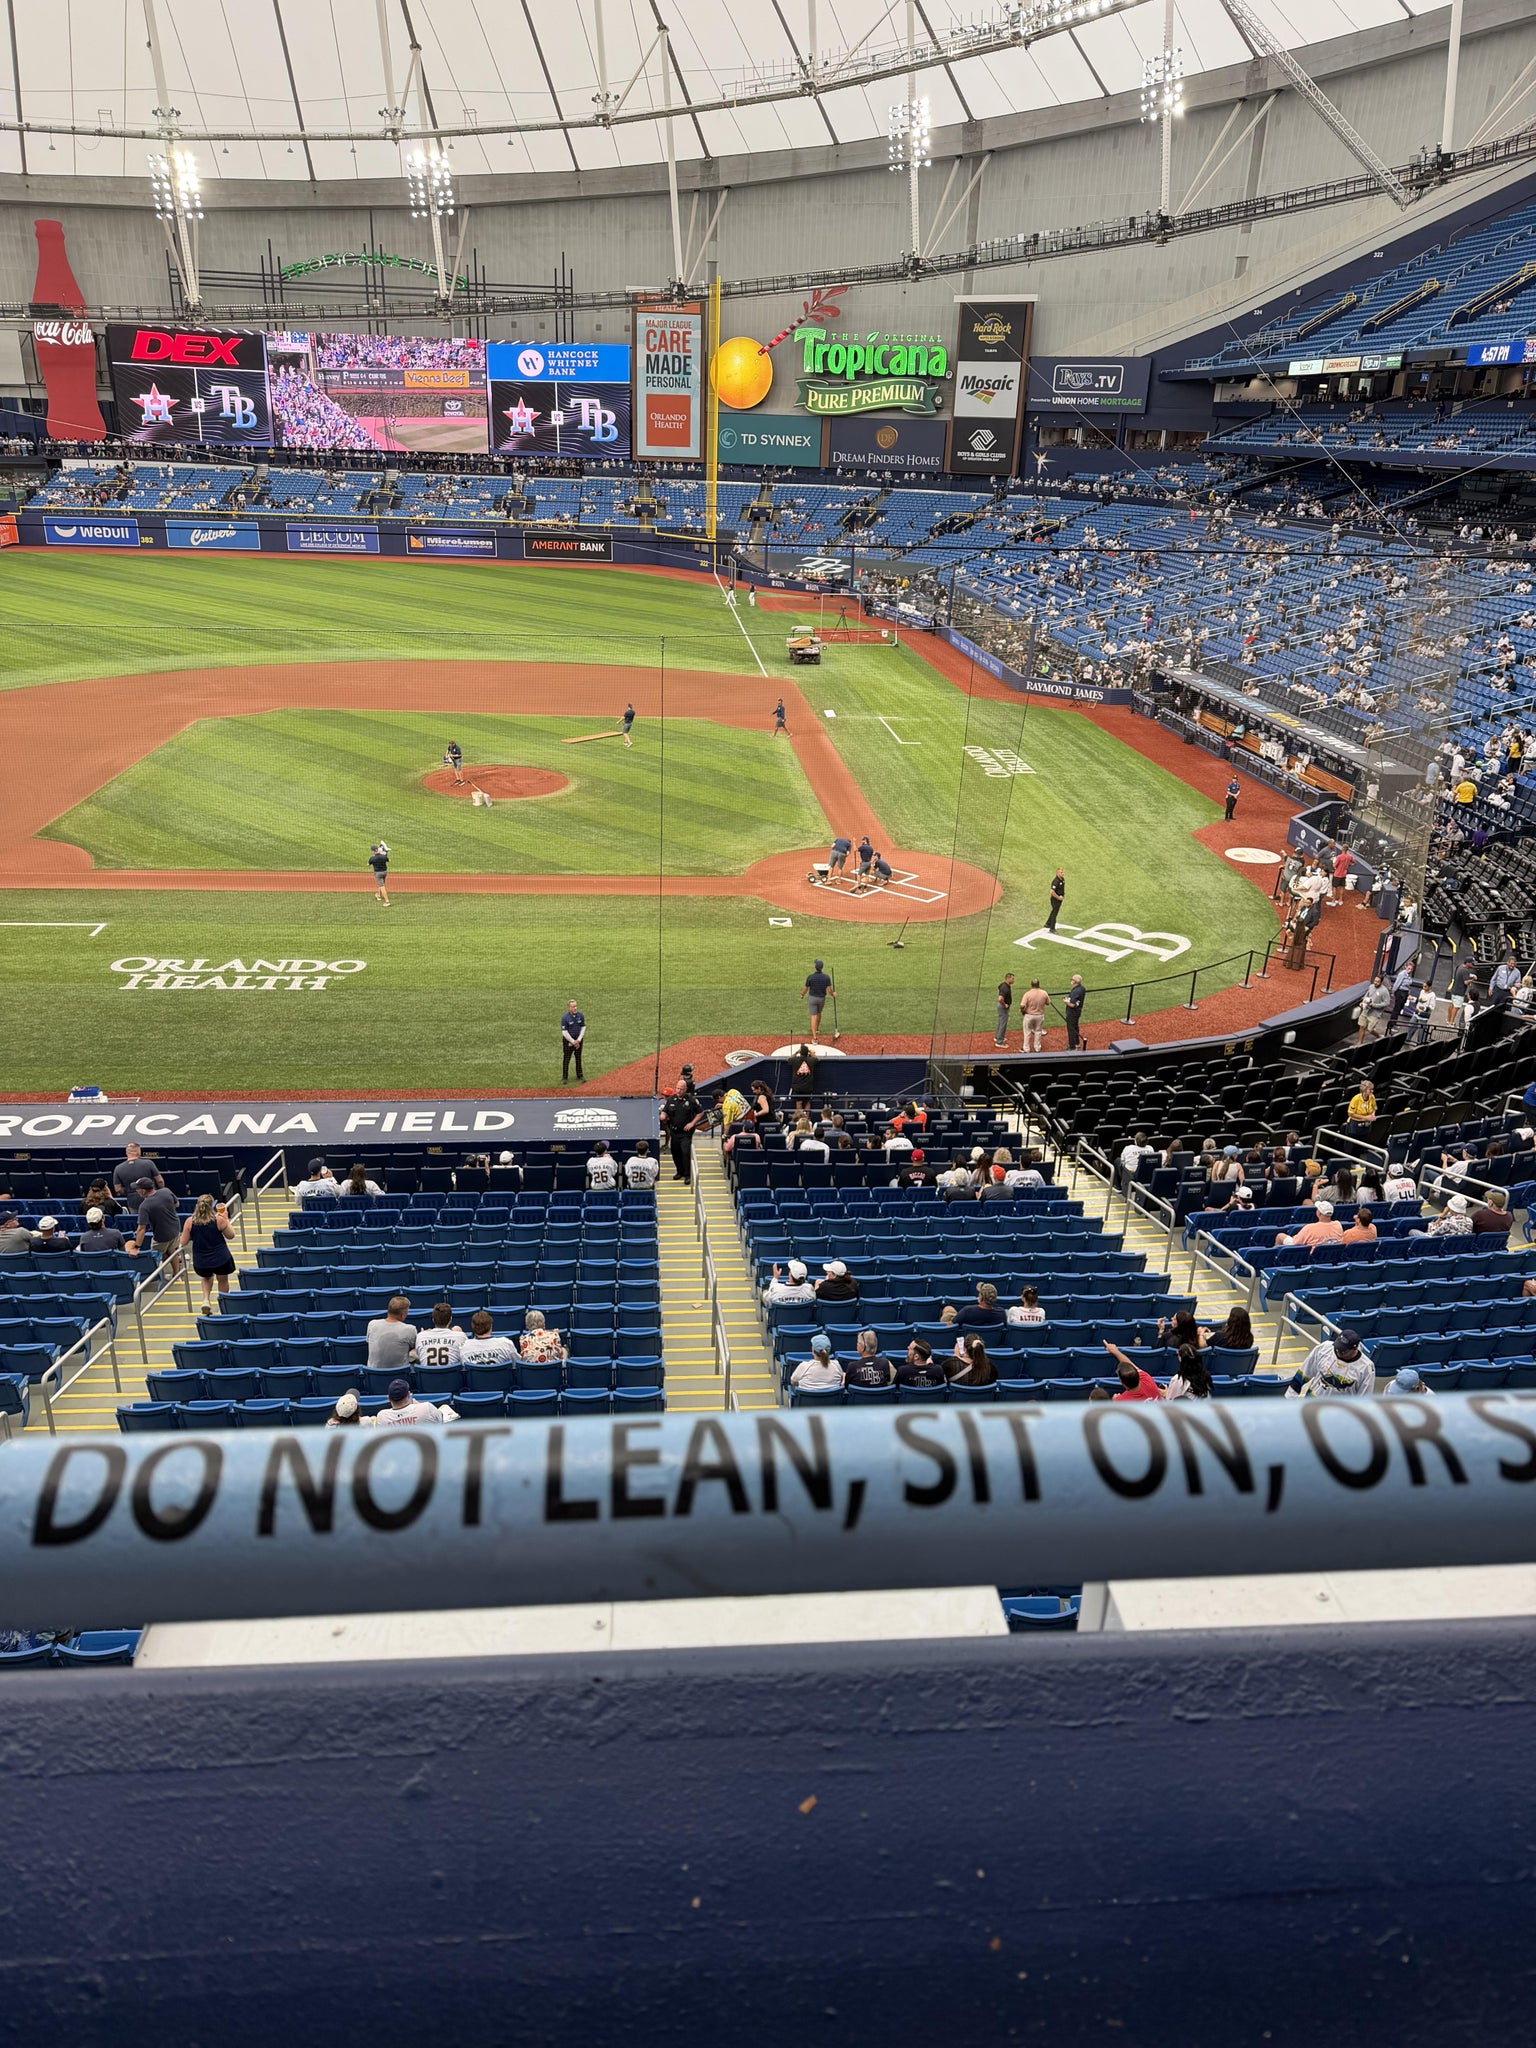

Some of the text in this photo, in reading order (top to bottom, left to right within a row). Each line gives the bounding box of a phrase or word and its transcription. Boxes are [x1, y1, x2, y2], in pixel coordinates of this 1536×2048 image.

[281, 252, 401, 280] TROPICANA
[646, 320, 691, 329] MAJOR LEAGUE
[973, 322, 1012, 335] Hard Rock
[646, 329, 692, 353] CARE
[831, 333, 942, 342] THE ORIGINAL
[131, 330, 243, 365] DEX
[794, 327, 948, 380] Tropicana
[1481, 345, 1510, 362] 4:57 PM
[646, 354, 692, 375] MADE
[407, 373, 465, 385] Vienna Beef
[549, 368, 576, 376] BANK
[646, 376, 691, 388] PERSONAL
[960, 375, 1014, 390] Mosaic
[808, 385, 925, 409] PURE PREMIUM
[1052, 397, 1076, 405] UNION
[1077, 397, 1099, 405] HOME
[1100, 398, 1142, 406] MORTGAGE
[210, 385, 257, 428] TB
[570, 398, 618, 442] TB
[650, 412, 687, 421] ORLANDO
[654, 421, 683, 429] HEALTH
[741, 433, 811, 447] TD SYNNEX
[833, 451, 940, 466] DREAM FINDERS HOMES
[531, 540, 605, 552] AMERANT BANK
[1026, 681, 1104, 700] RAYMOND JAMES
[110, 957, 367, 973] ORLANDO
[119, 973, 330, 990] HEALTH
[344, 1110, 515, 1133] FIELD
[554, 1114, 618, 1123] Tropicana
[593, 1171, 608, 1183] 26
[632, 1171, 646, 1183] 26
[1399, 1189, 1415, 1200] 44
[421, 1339, 440, 1347] TAMPA
[427, 1348, 449, 1366] 26
[468, 1353, 486, 1362] TAMPA
[32, 1440, 224, 1546] DO
[258, 1428, 510, 1537] NOT
[544, 1414, 866, 1531] LEAN,
[895, 1408, 1043, 1505] SIT
[1083, 1402, 1285, 1514] ON,
[1302, 1396, 1469, 1490] OR
